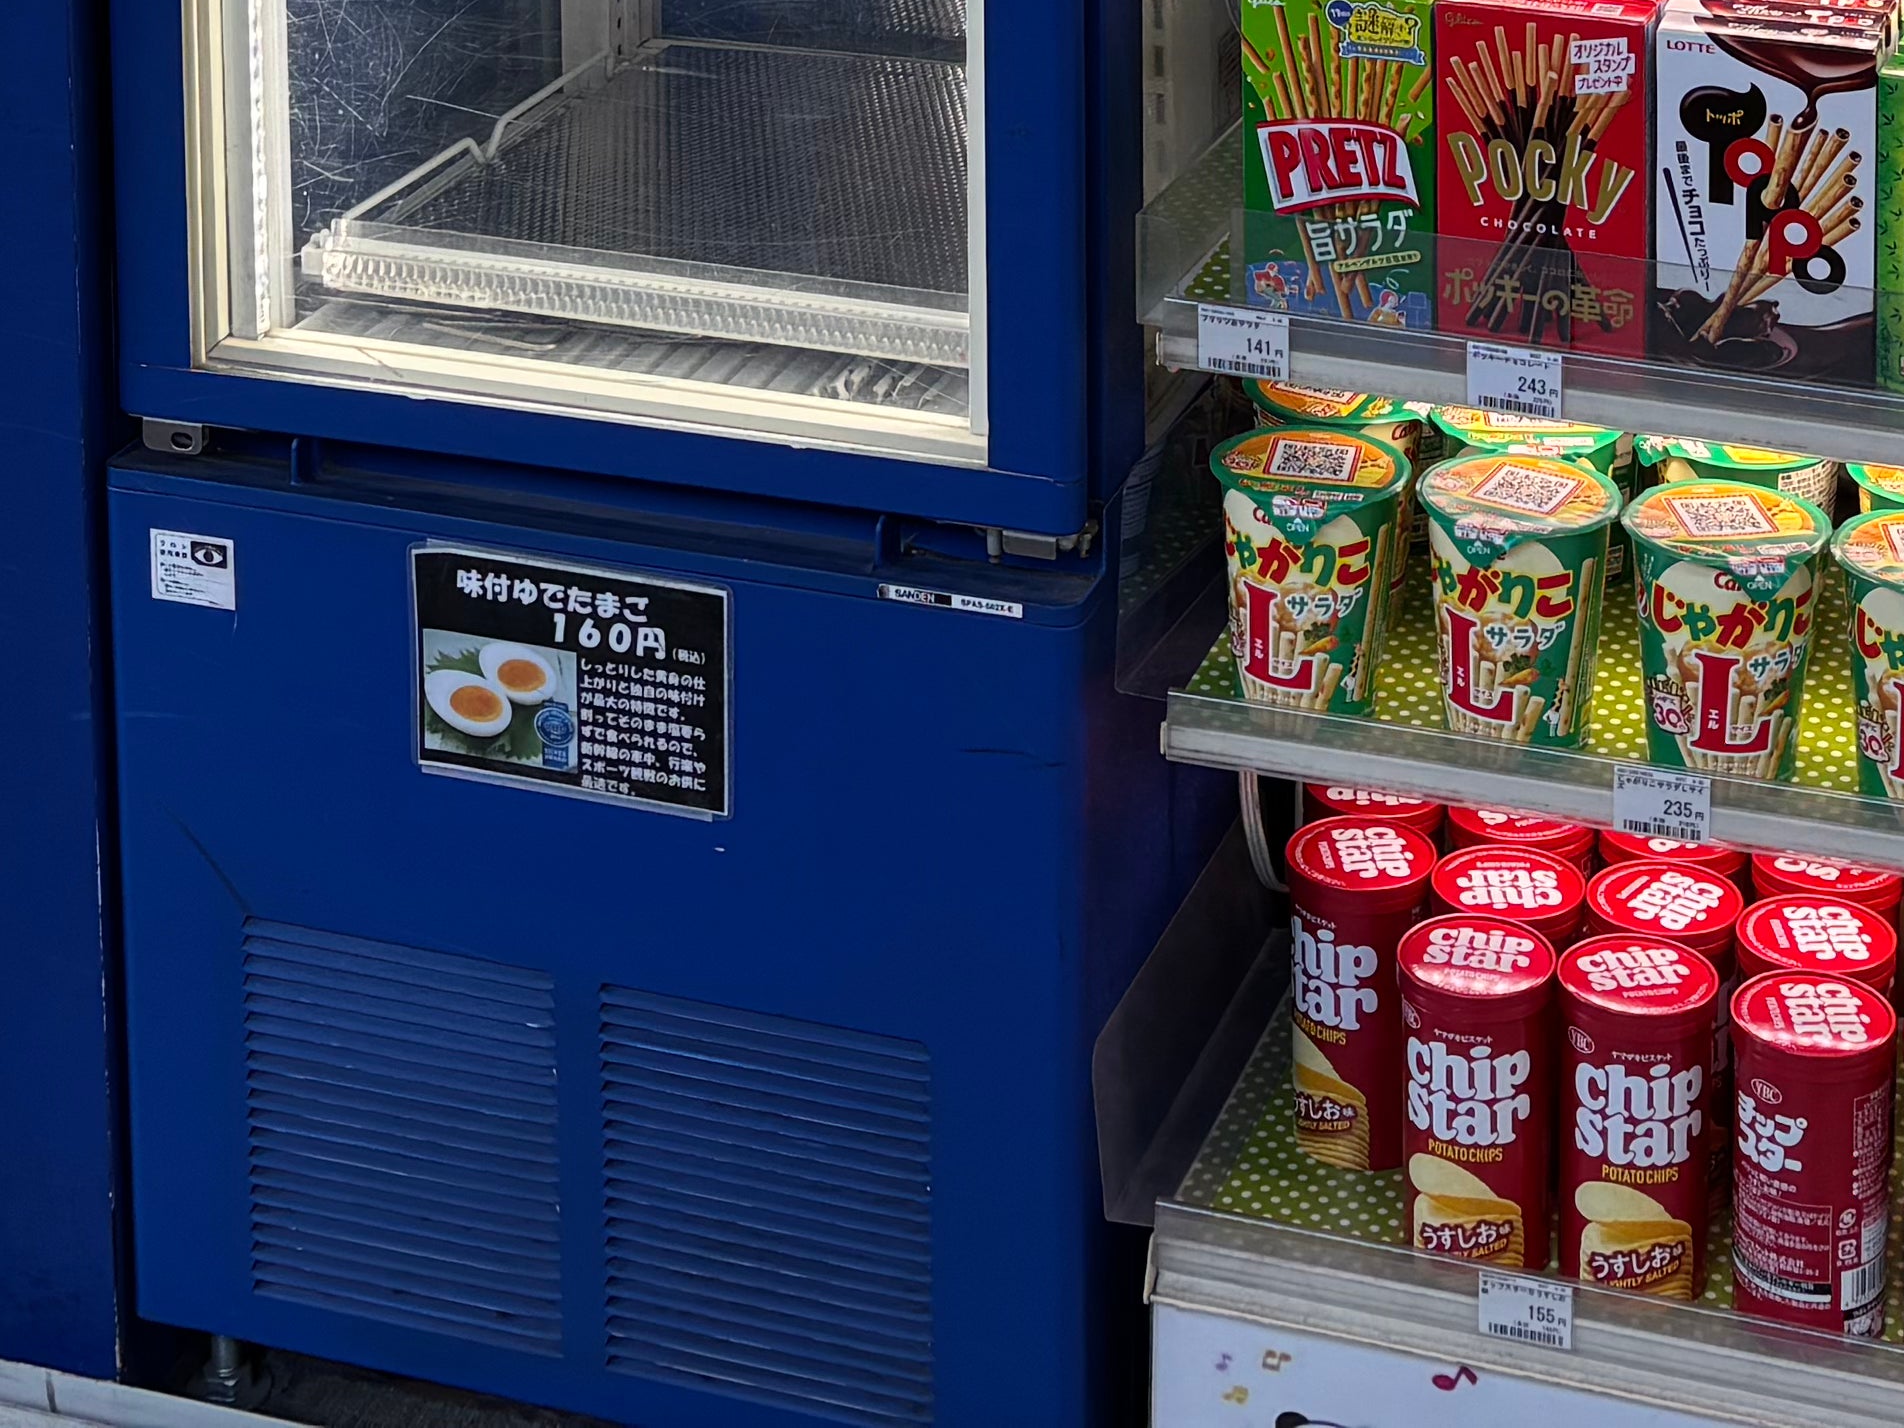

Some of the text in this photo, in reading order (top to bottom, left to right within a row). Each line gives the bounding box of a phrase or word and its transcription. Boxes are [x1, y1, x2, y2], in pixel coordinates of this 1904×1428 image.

[1666, 38, 1717, 54] LOTTE
[1272, 126, 1407, 201] PRETZ
[1304, 207, 1412, 263] 旨サラダ
[1480, 217, 1598, 239] CHOCOLATE
[552, 612, 667, 661] 160円
[1663, 798, 1704, 819] 235円
[1737, 1089, 1807, 1145] チップ
